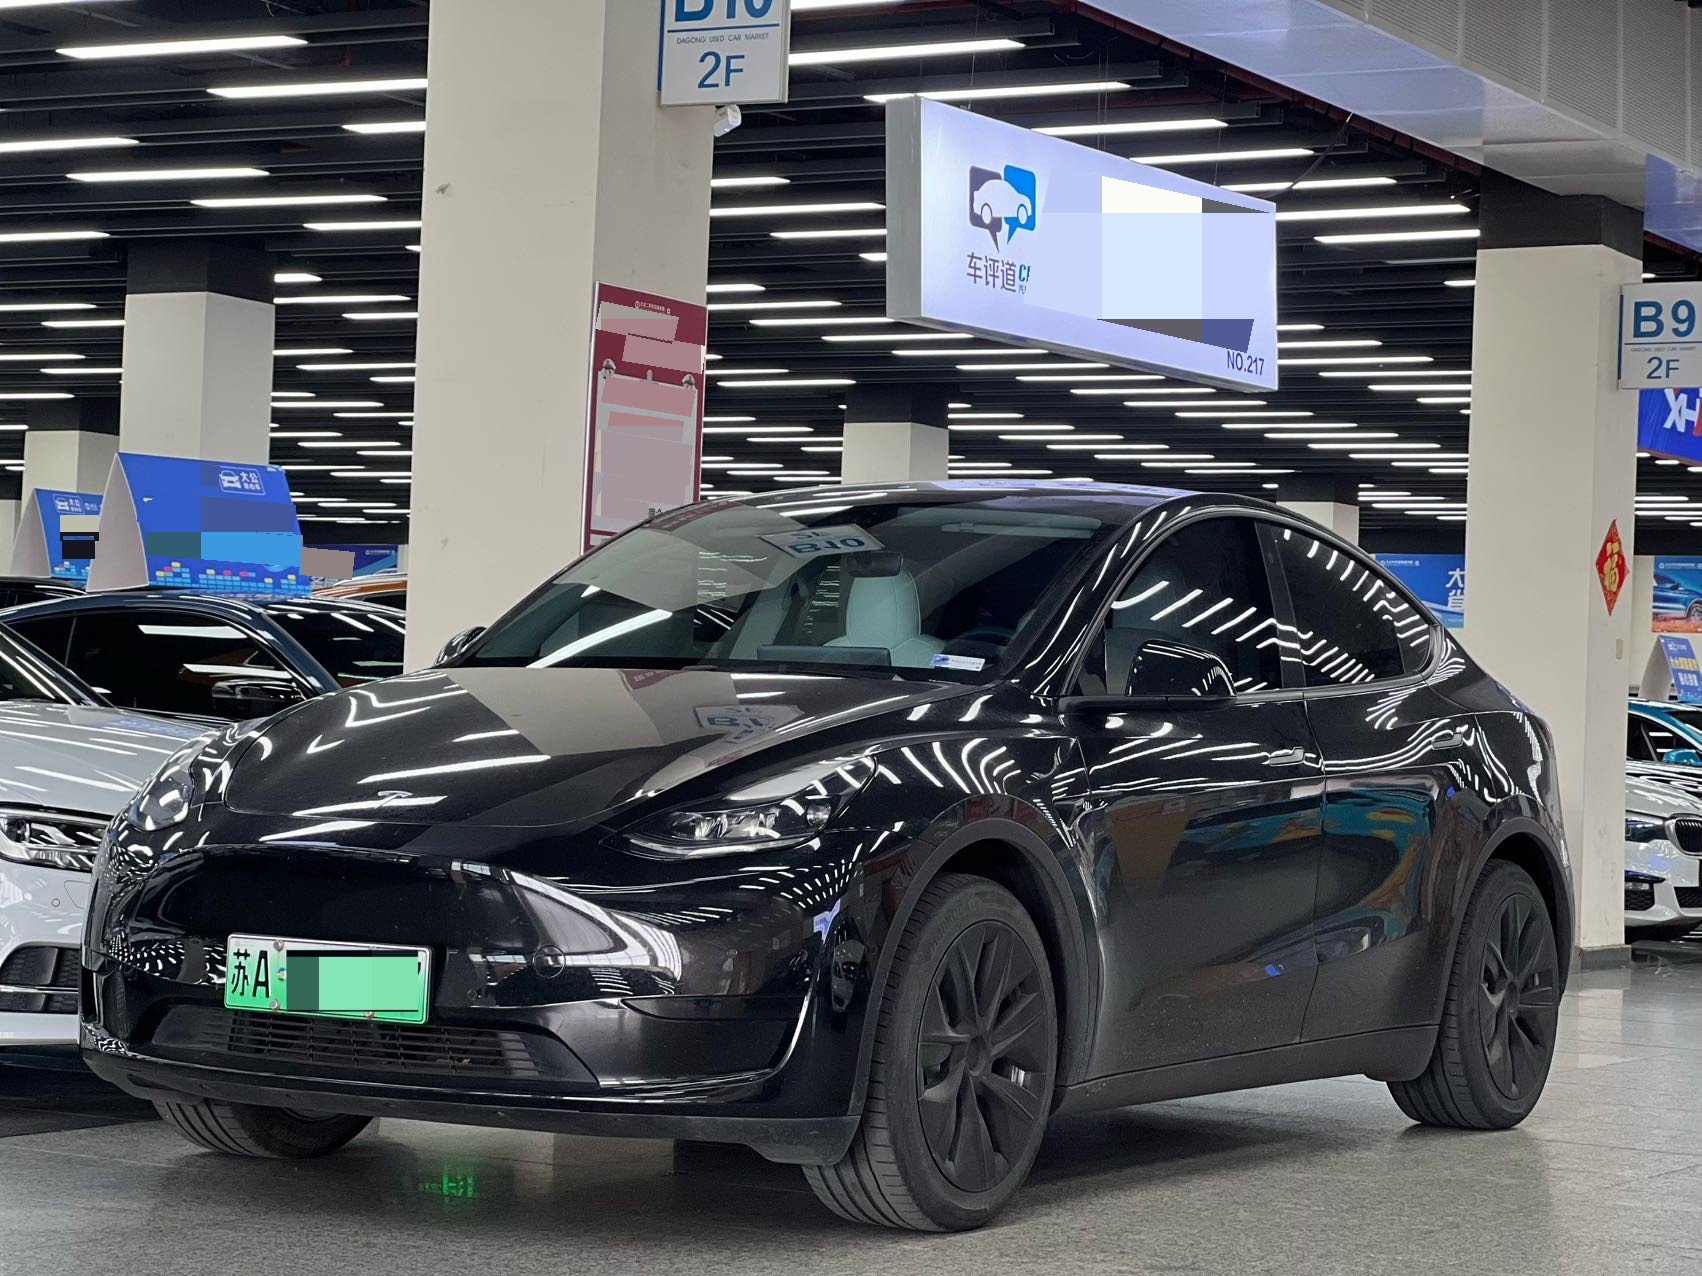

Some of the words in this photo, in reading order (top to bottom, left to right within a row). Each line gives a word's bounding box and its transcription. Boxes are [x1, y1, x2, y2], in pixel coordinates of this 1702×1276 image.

[676, 36, 706, 45] DAGONG
[709, 35, 725, 43] USED
[728, 34, 742, 42] CAR
[744, 32, 769, 41] MARKET
[697, 51, 745, 88] 2F
[966, 252, 1017, 293] 车评道
[1632, 299, 1697, 338] B9
[1226, 350, 1265, 375] NO.217
[1646, 356, 1680, 380] 2F
[231, 948, 271, 999] 苏A
